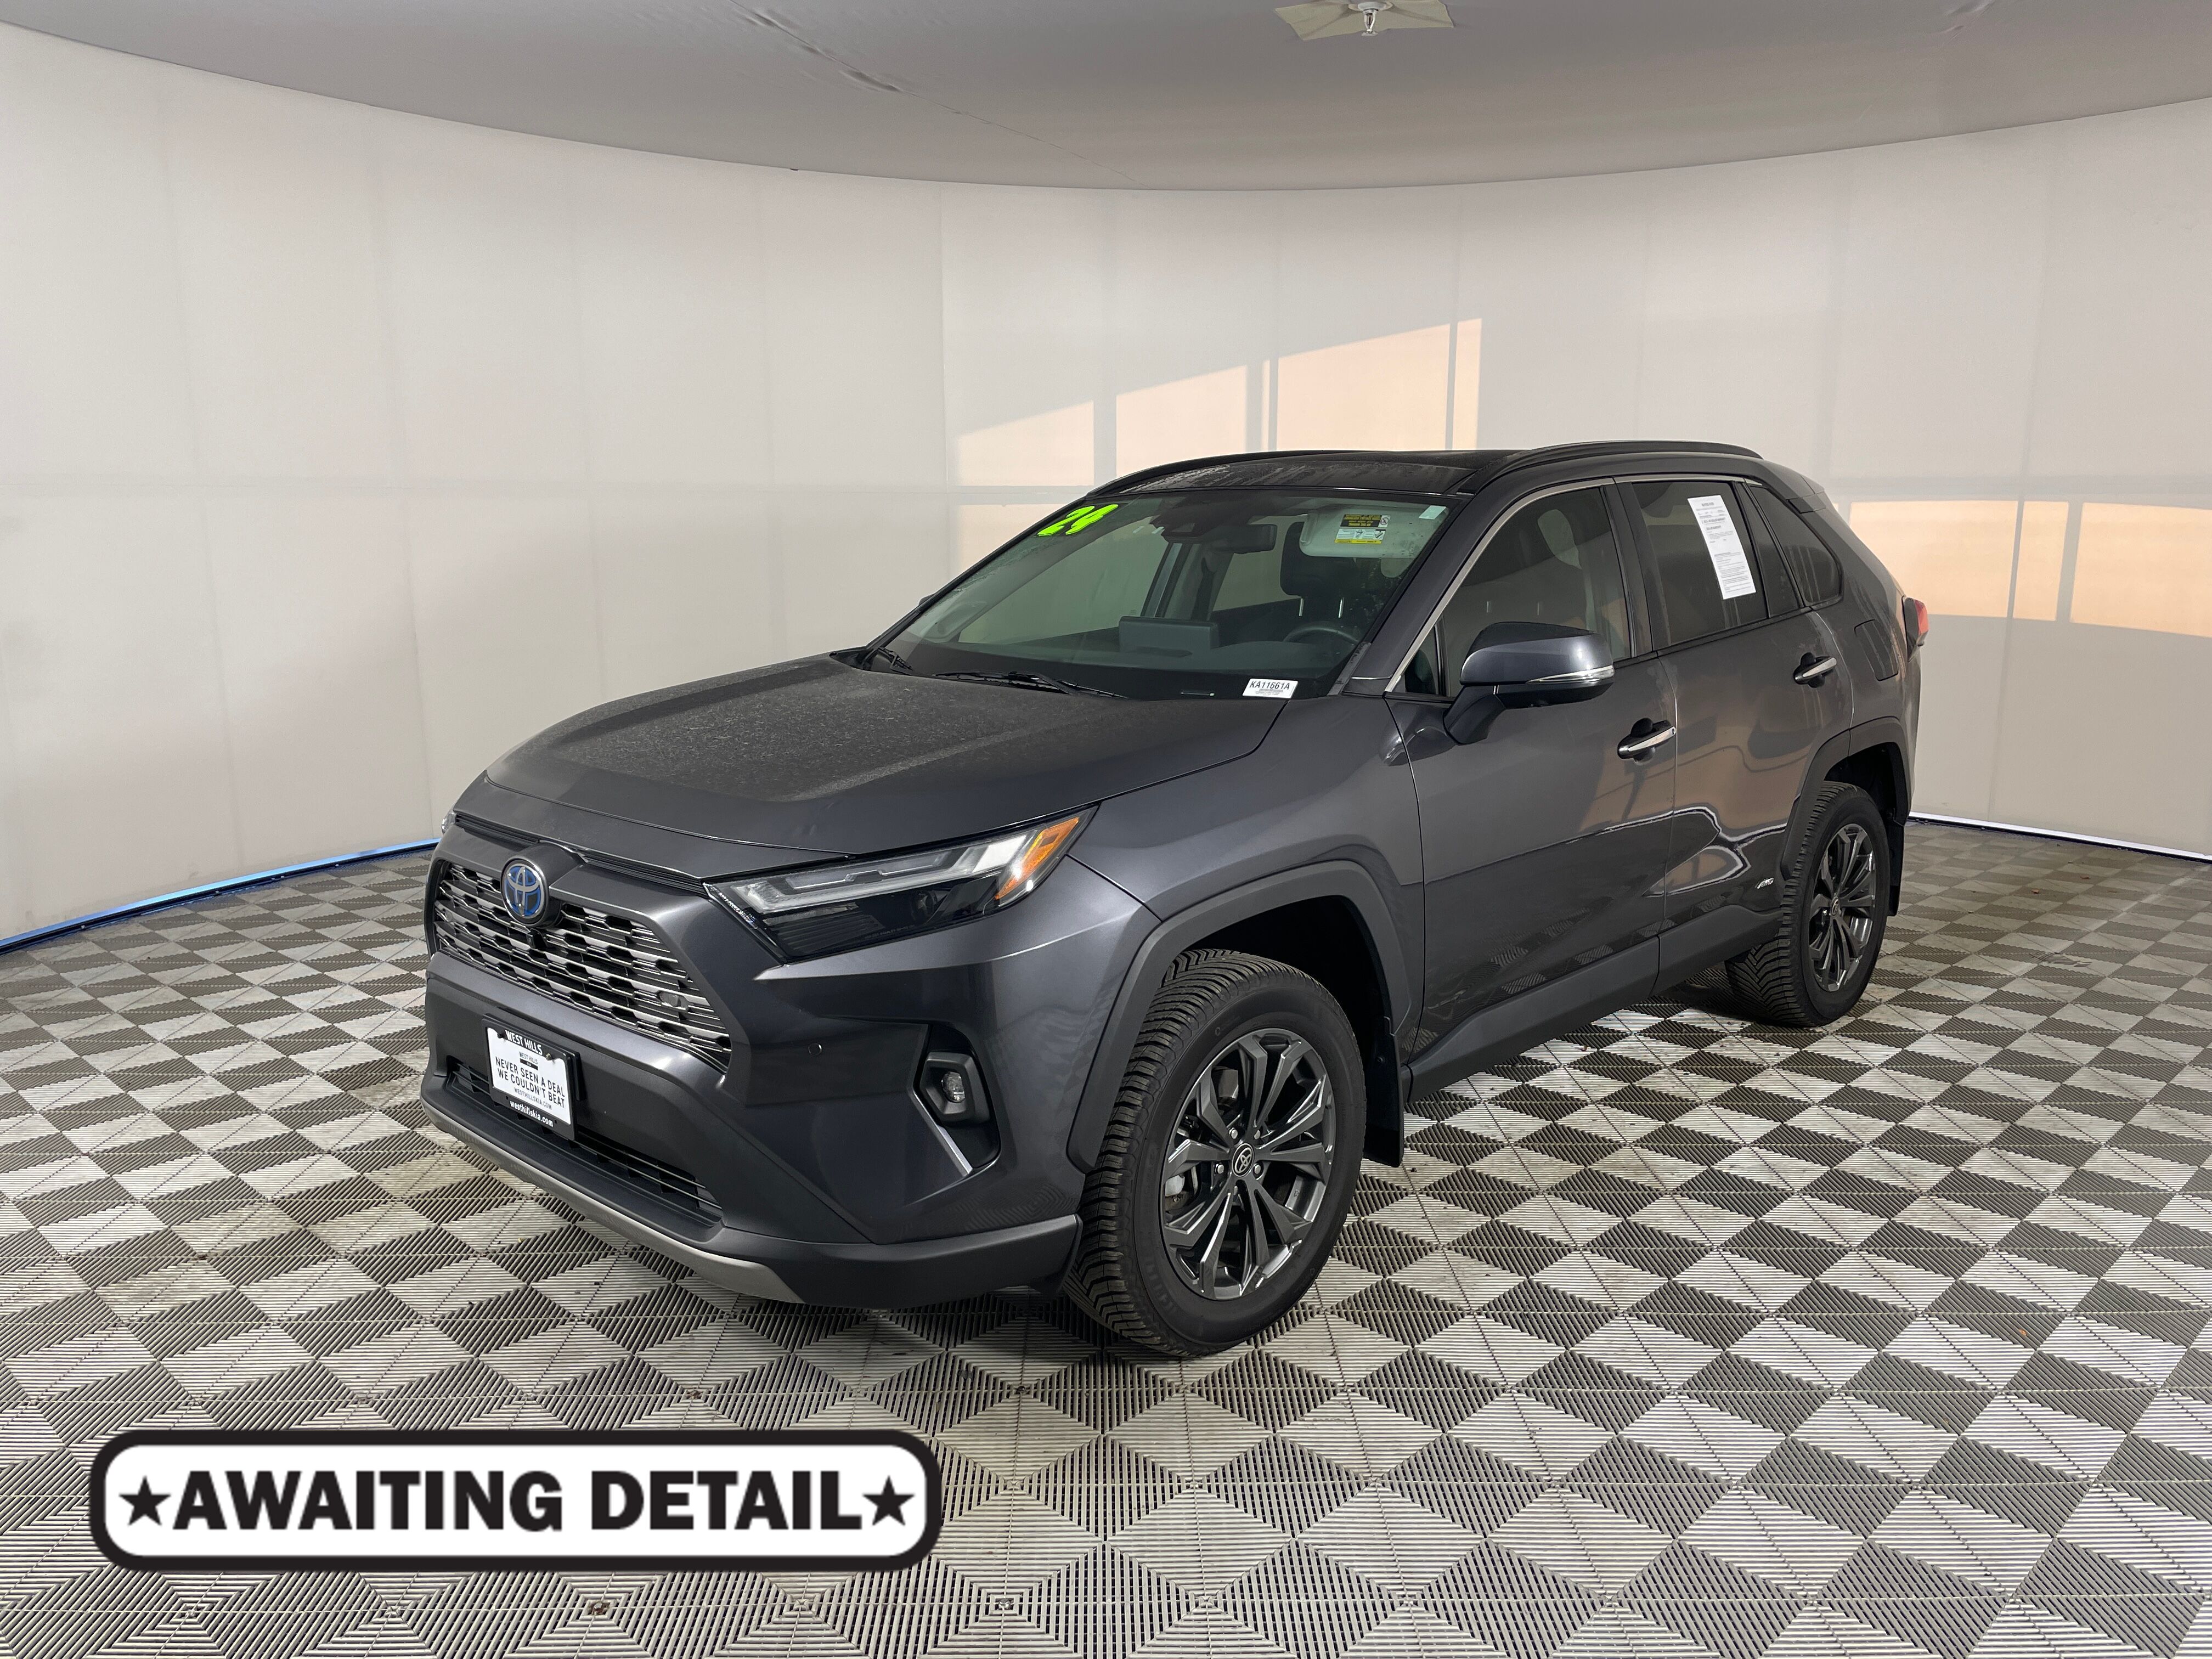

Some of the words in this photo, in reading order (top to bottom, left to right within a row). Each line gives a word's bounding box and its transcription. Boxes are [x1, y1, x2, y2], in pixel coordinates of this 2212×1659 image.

[1250, 681, 1290, 690] KA11661A
[505, 1030, 523, 1047] WEST
[525, 1037, 543, 1056] HILLS
[519, 1051, 528, 1060] WEST
[495, 1056, 518, 1075] NEVER
[521, 1067, 539, 1084] SEEN
[541, 1076, 546, 1087] A
[548, 1080, 565, 1097] DEAL
[498, 1068, 509, 1081] WE
[510, 1074, 546, 1098] COULDN'T
[549, 1092, 565, 1108] BEAT
[510, 1101, 554, 1127] westhillskia.com
